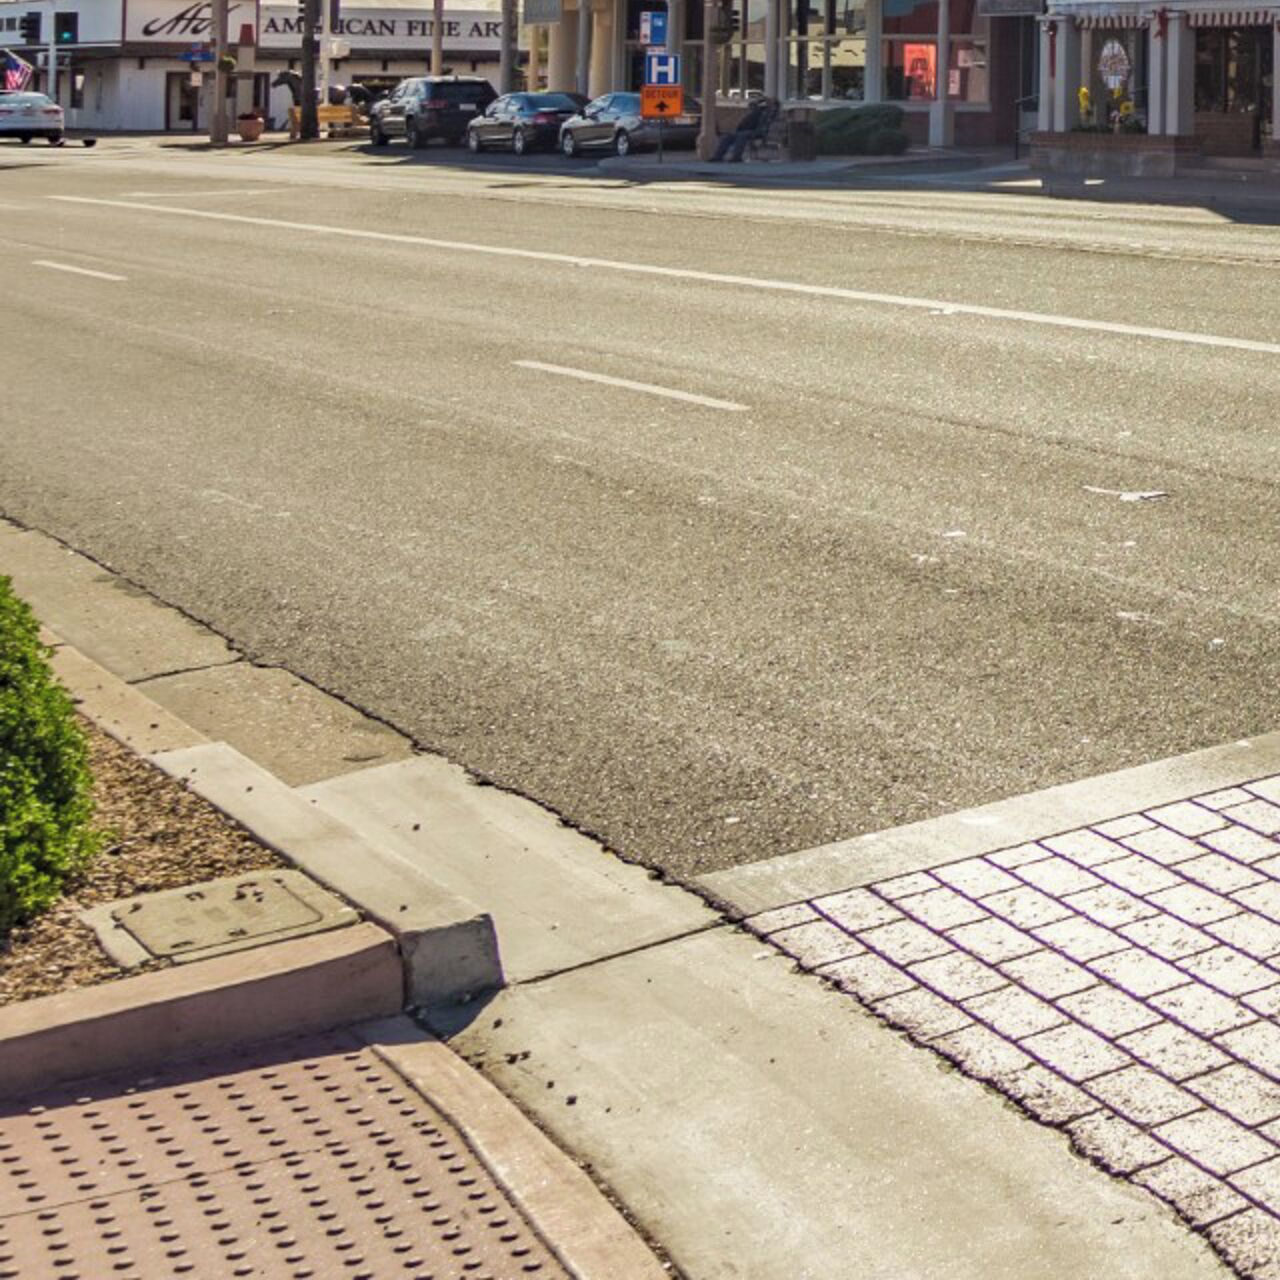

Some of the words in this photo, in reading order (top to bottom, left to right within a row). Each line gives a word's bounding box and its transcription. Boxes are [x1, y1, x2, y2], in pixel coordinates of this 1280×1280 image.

[264, 18, 396, 36] AMICAN
[469, 21, 504, 38] AR
[651, 57, 675, 83] H
[645, 89, 679, 99] DETOUR
